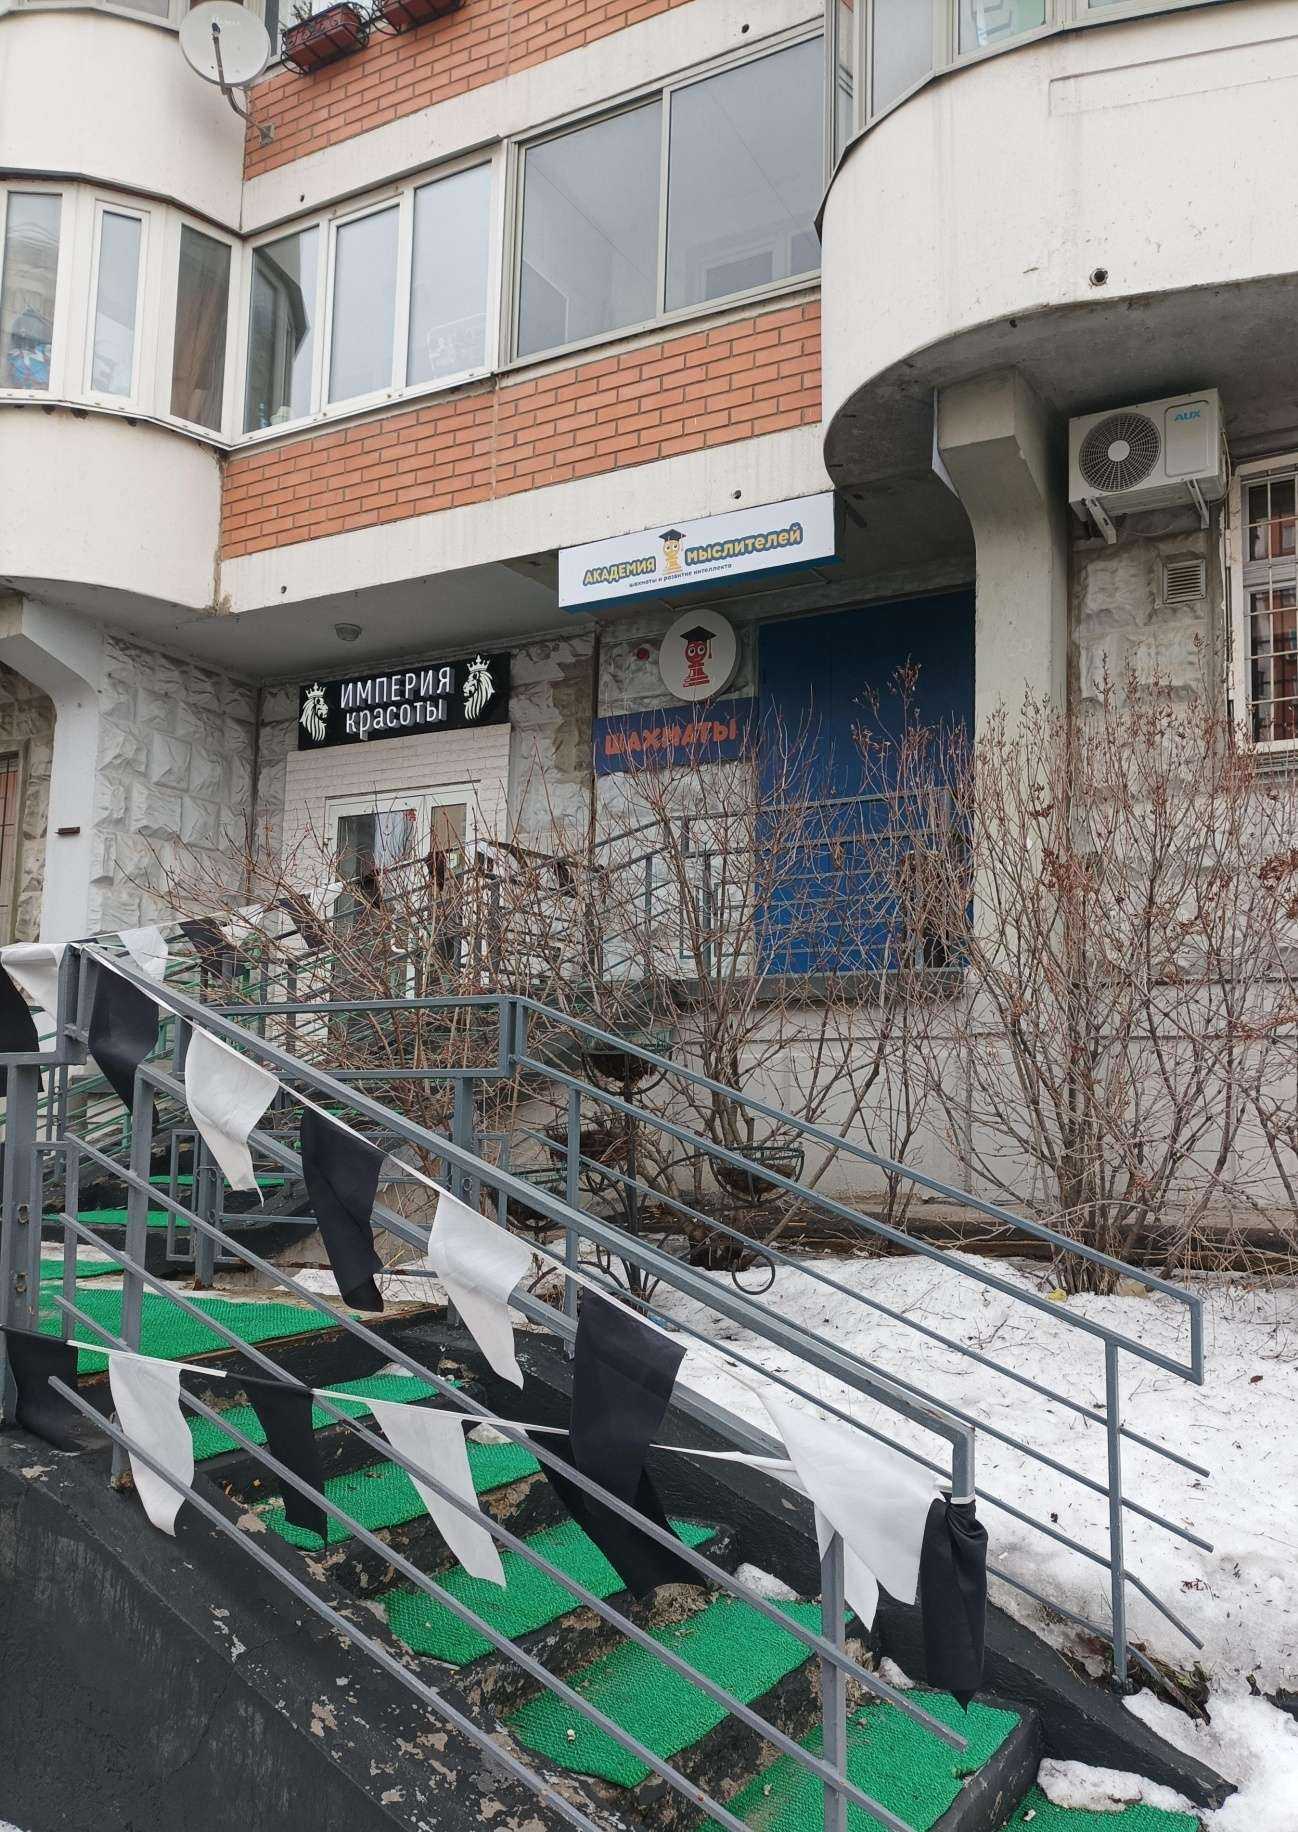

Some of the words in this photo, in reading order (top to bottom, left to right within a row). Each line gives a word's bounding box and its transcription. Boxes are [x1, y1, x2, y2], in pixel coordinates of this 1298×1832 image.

[1174, 409, 1201, 421] AUX
[583, 556, 656, 586] АКАДЕМИЯ
[685, 522, 803, 565] мыслителей
[663, 571, 692, 582] развитие
[693, 563, 732, 575] интеллекта
[340, 666, 452, 709] ИМПЕРИЯ
[346, 699, 445, 740] красоты
[604, 718, 738, 756] ШАХМАТЫ
